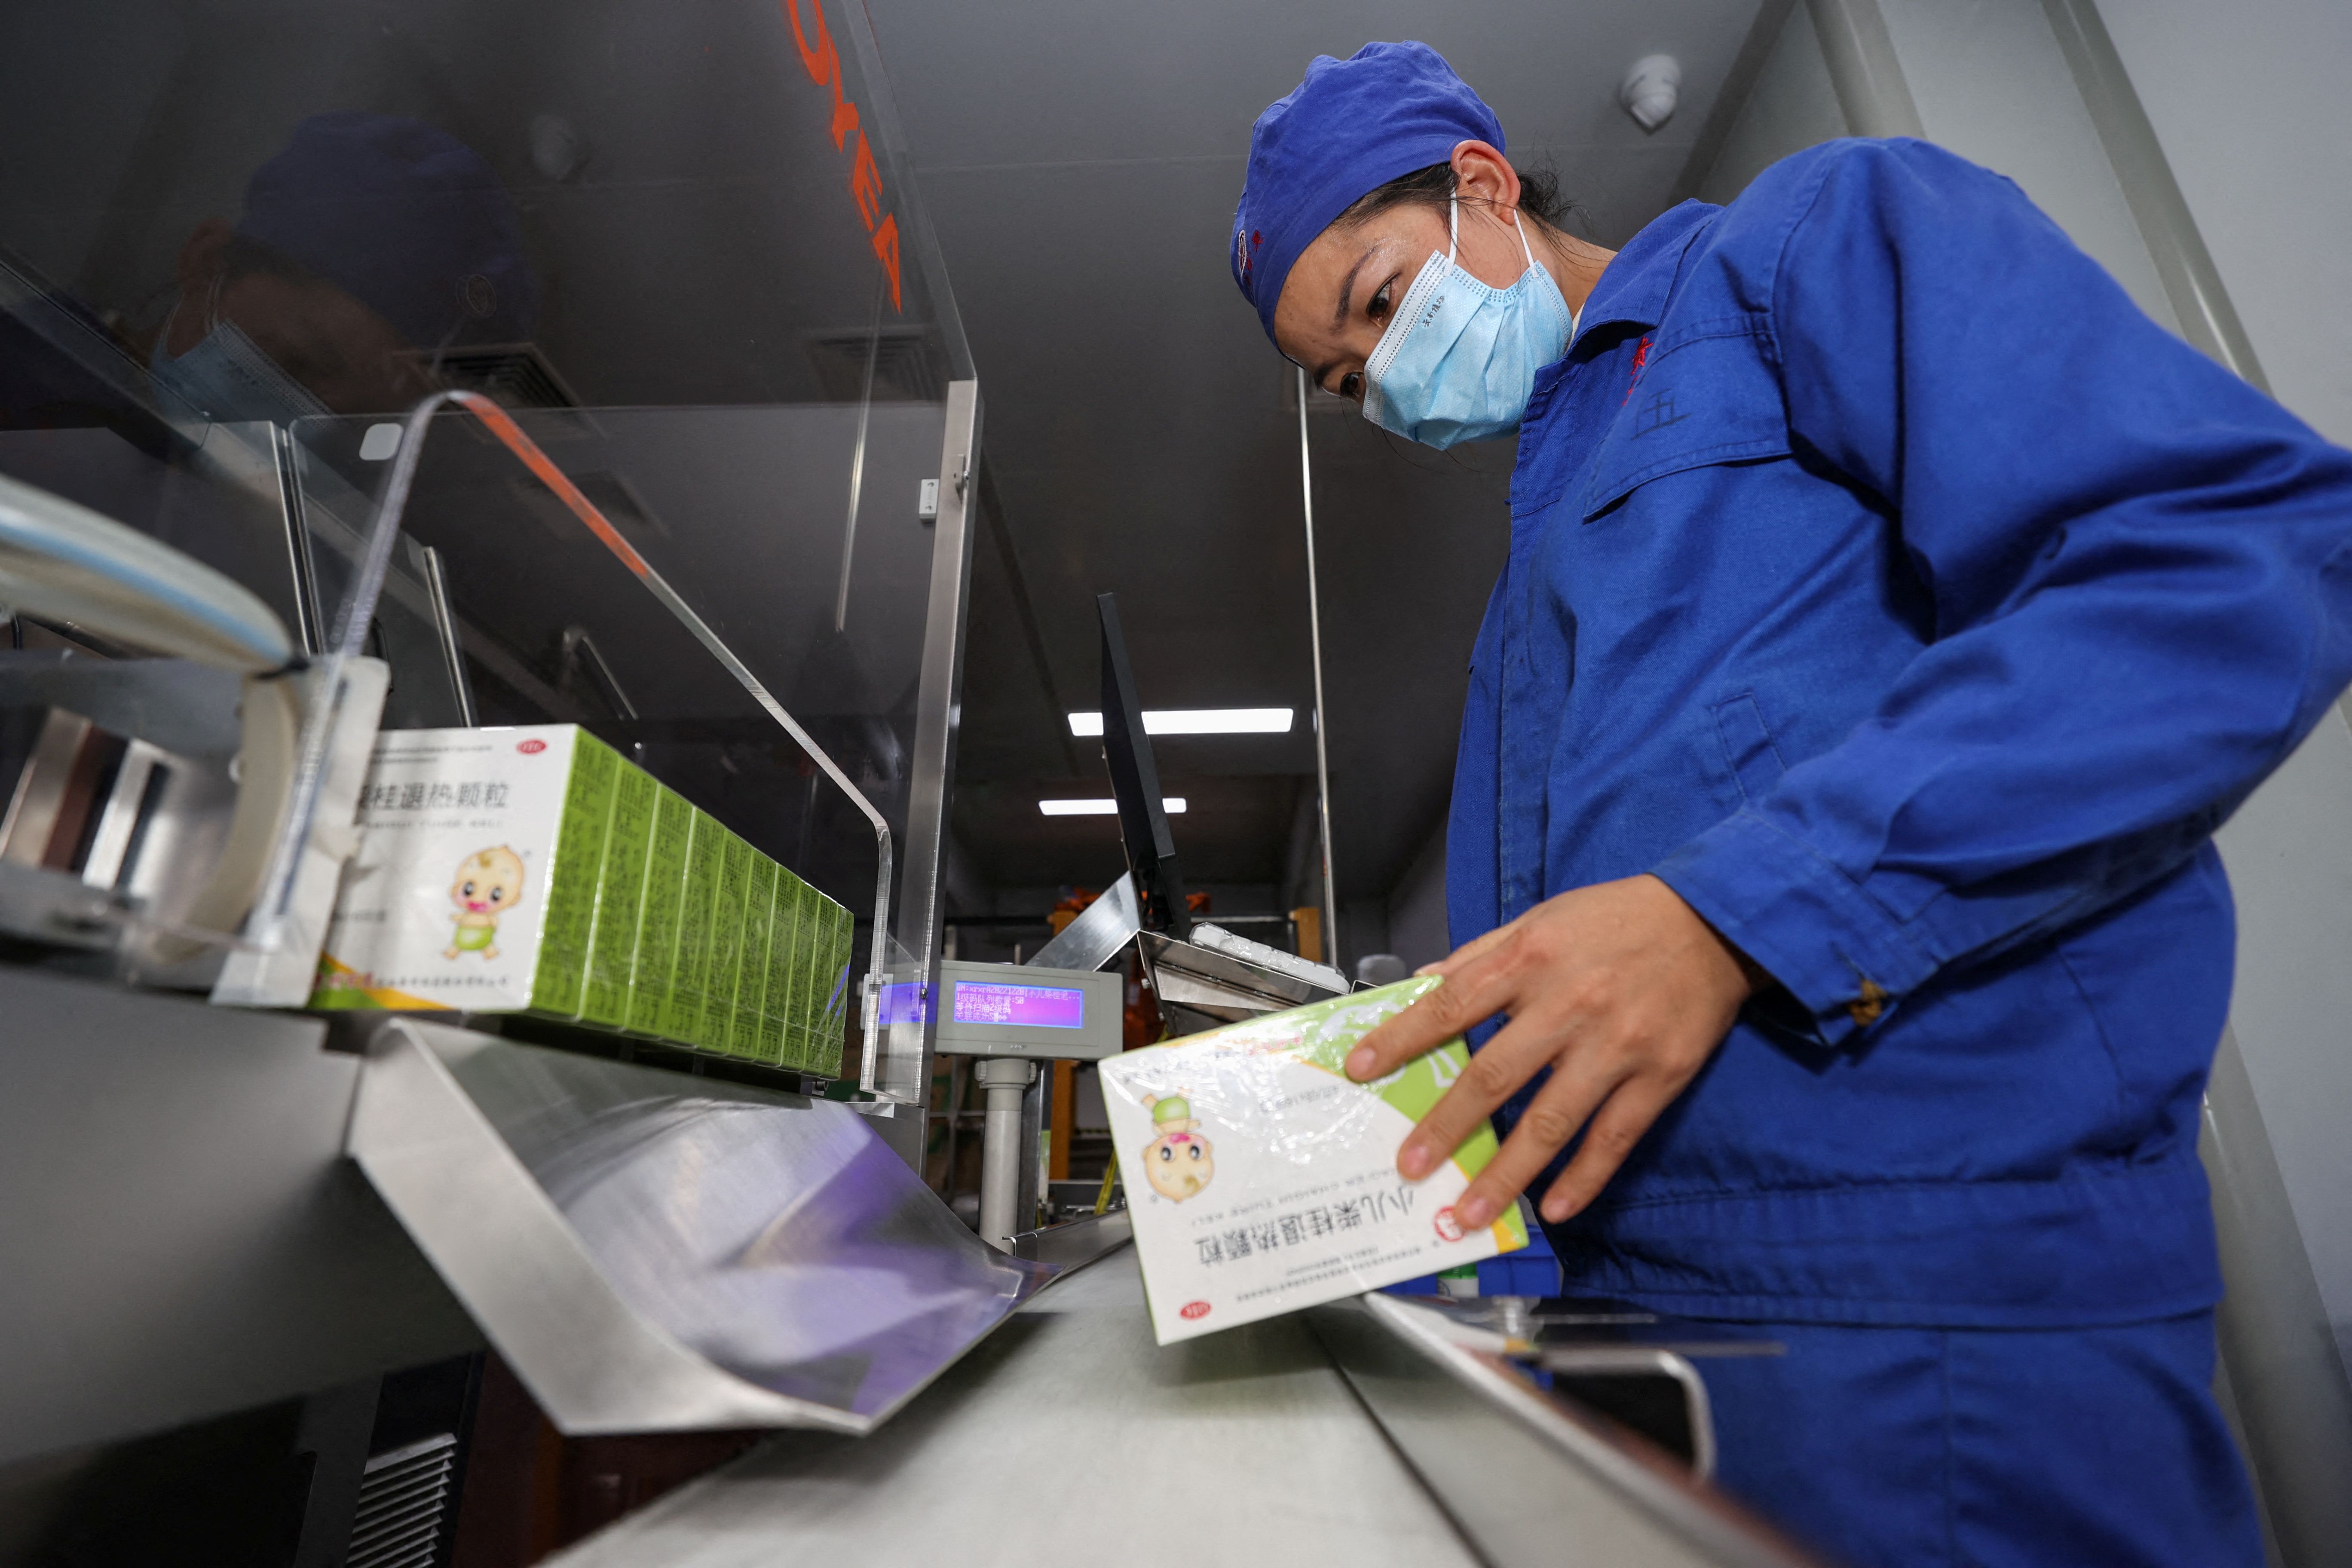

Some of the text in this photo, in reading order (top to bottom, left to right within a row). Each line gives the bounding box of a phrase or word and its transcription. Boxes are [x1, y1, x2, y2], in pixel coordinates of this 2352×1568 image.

[1194, 1185, 1417, 1268] 小儿柴桂退热颗粒
